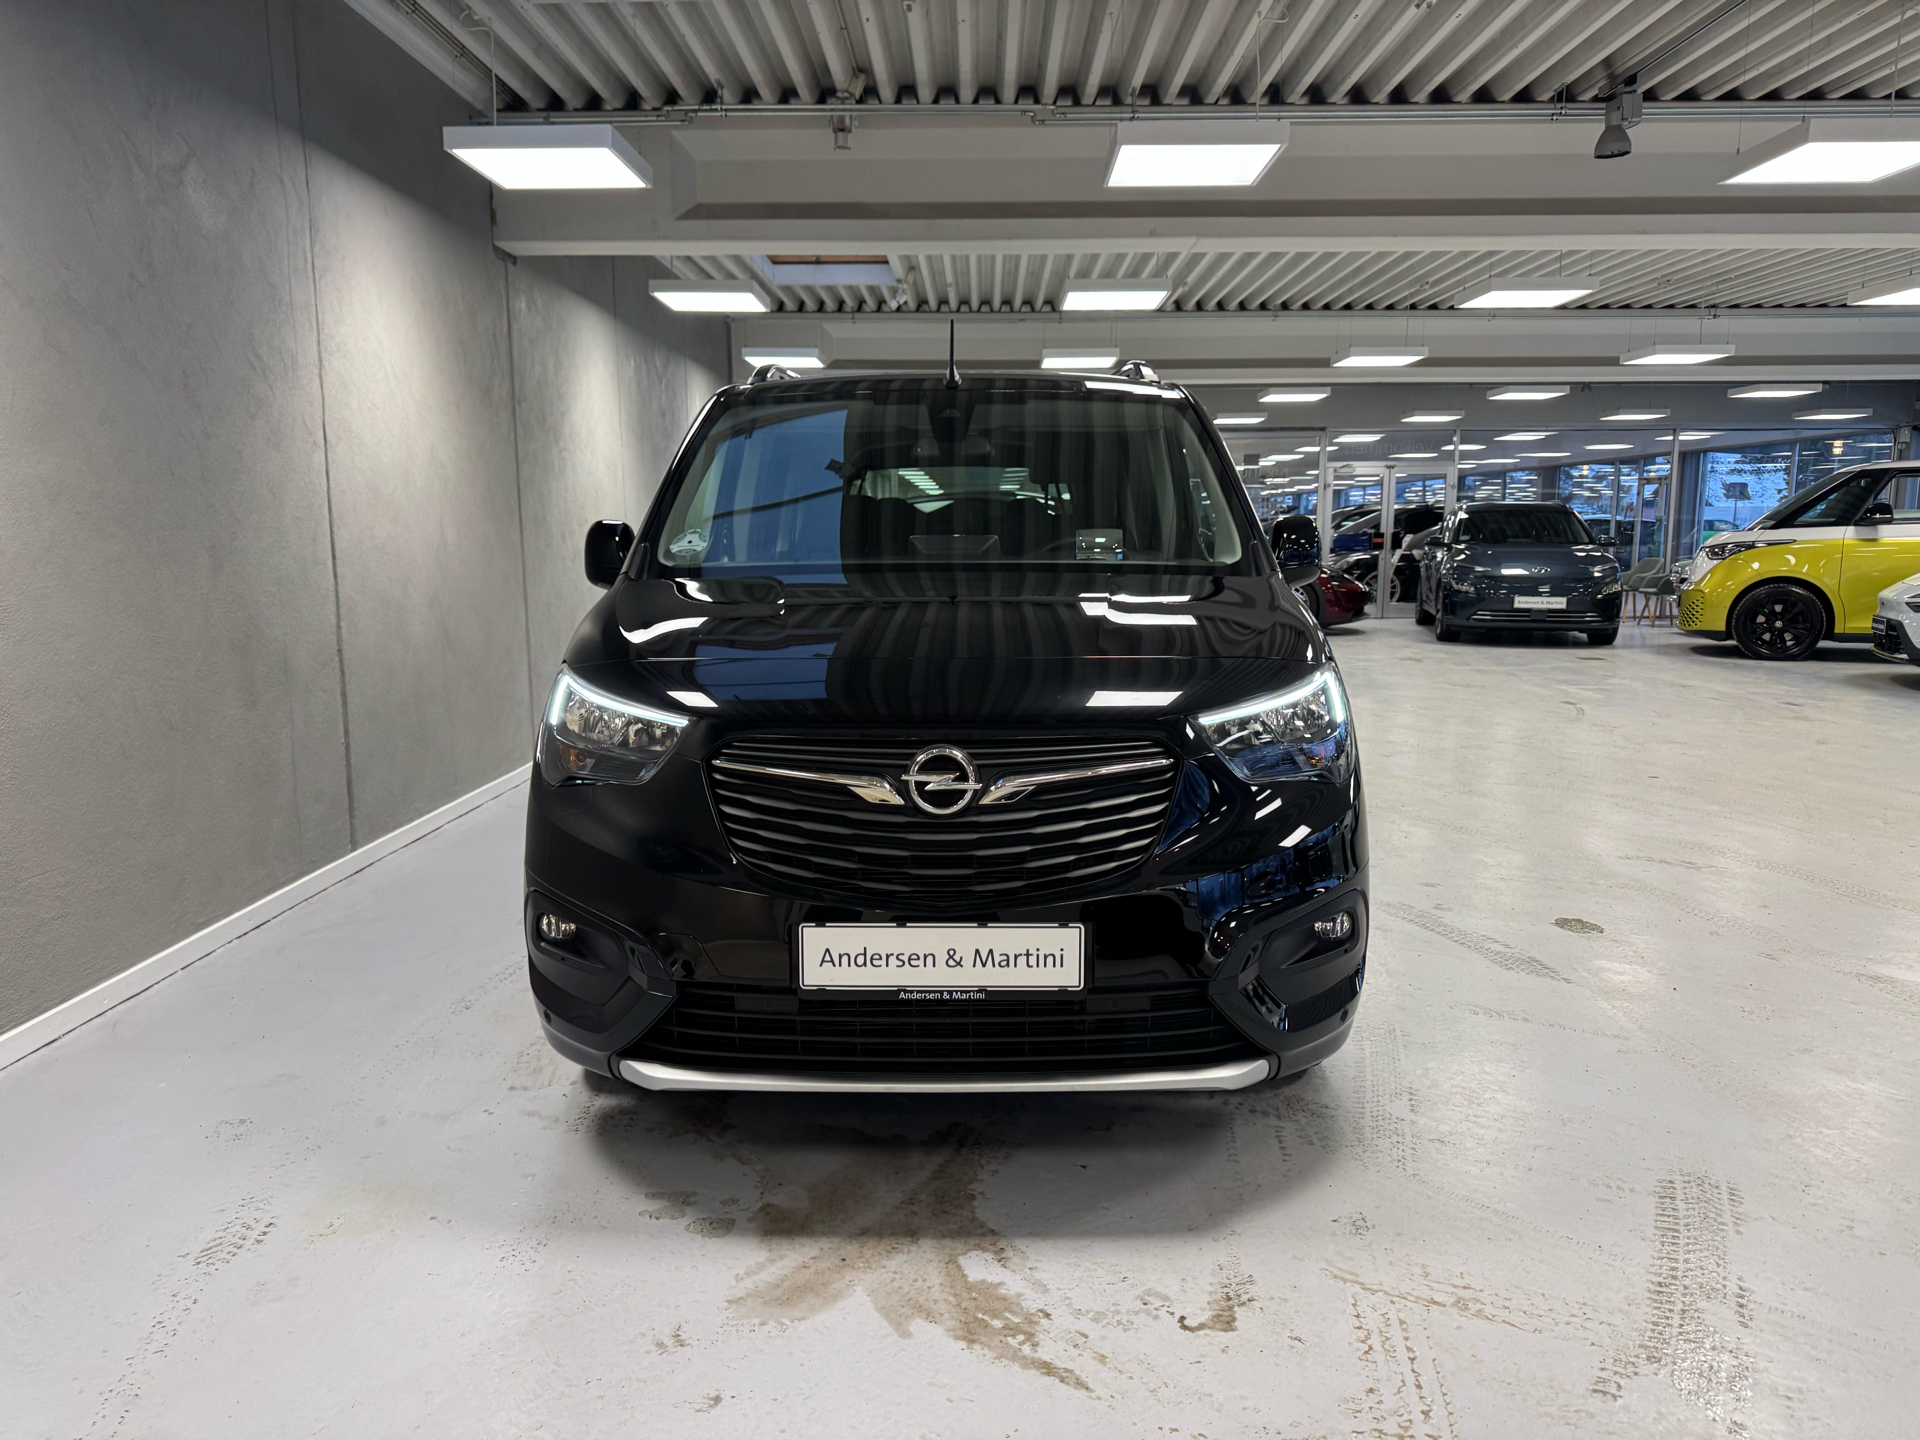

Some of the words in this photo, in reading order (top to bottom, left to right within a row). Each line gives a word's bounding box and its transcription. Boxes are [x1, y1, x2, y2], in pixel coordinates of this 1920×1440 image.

[819, 946, 936, 968] Andersen
[945, 948, 963, 968] &
[972, 948, 1064, 968] Martini
[899, 991, 941, 999] Andersen
[942, 991, 950, 999] &
[952, 991, 985, 999] Martini
